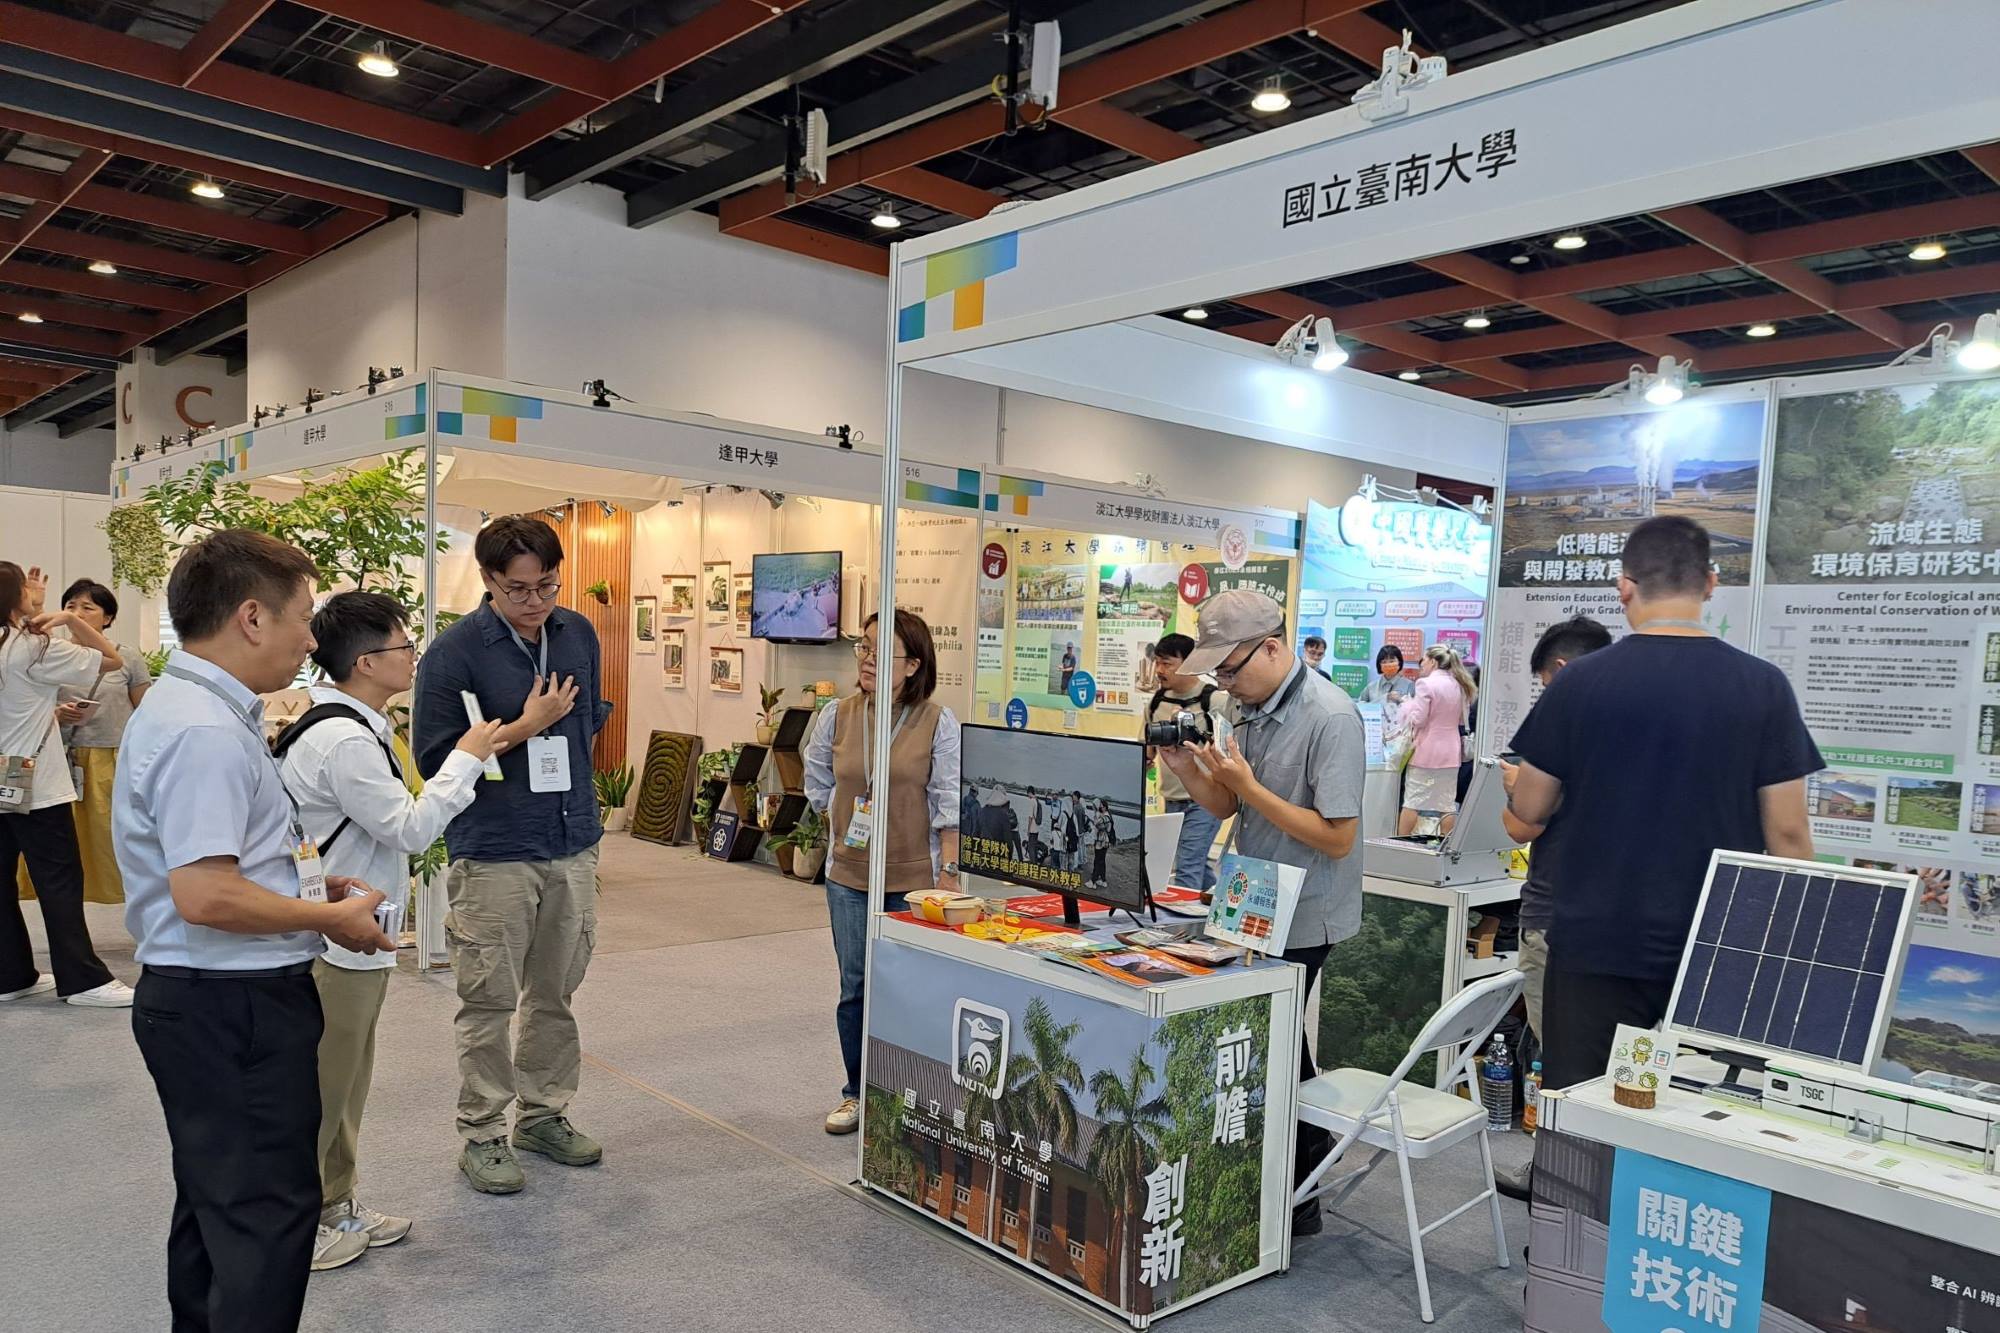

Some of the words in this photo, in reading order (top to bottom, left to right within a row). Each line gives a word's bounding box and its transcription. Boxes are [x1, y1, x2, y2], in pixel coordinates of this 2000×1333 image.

[1283, 128, 1517, 229] 國立臺南大學
[175, 385, 216, 429] C
[718, 443, 779, 469] 逢甲大學
[905, 467, 920, 478] 516
[1095, 501, 1221, 531] 淡江大學學校財團法人淡江大學
[1867, 518, 1984, 546] 流域生態
[1526, 593, 1571, 602] Extension
[1562, 606, 1573, 614] of
[1575, 606, 1595, 615] Low
[1785, 605, 1877, 615] Environmental
[1881, 604, 1969, 616] Conservation
[1973, 605, 1989, 616] of
[1837, 591, 1880, 601] Center
[1883, 591, 1901, 601] for
[1905, 591, 1974, 603] Ecological
[963, 835, 1010, 858] 除了營隊外
[963, 849, 1082, 889] 還有大學端的課程戶外教學
[960, 1076, 994, 1099] NUTN
[1212, 1023, 1252, 1146] 前瞻
[1800, 1085, 1825, 1101] TSGC
[903, 1087, 1053, 1164] 國立臺南大學
[901, 1113, 941, 1140] National
[945, 1131, 997, 1163] University
[1001, 1154, 1014, 1169] of
[1016, 1159, 1050, 1186] Tainan
[1139, 1153, 1189, 1288] 創新
[1637, 1187, 1743, 1267] 關鍵
[1630, 1247, 1738, 1329] 技術
[1930, 1274, 1960, 1295] 整合
[1962, 1286, 1977, 1299] AI
